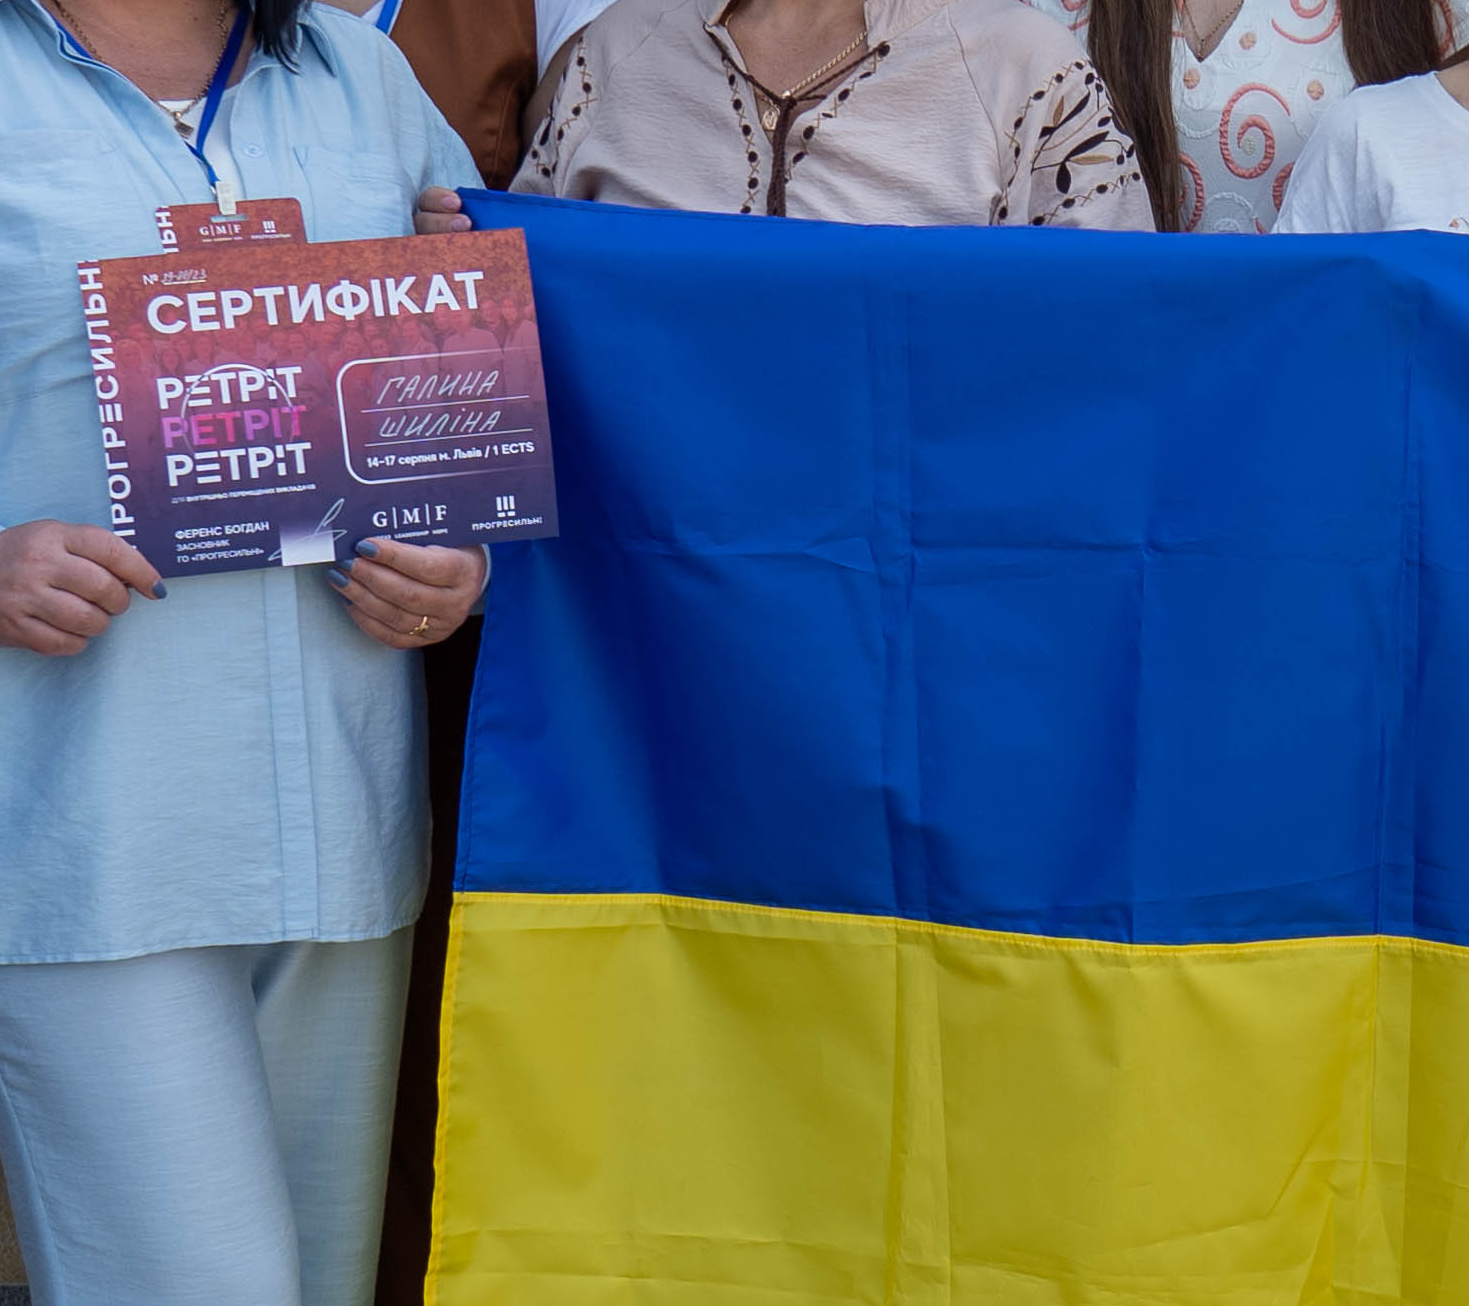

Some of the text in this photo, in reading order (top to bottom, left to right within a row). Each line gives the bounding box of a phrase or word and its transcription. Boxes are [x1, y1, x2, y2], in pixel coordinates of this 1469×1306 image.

[146, 271, 484, 333] СЕРТИФІКАТ
[377, 370, 499, 405] ГАЛИНА
[453, 448, 482, 460] Львів
[501, 442, 535, 454] ECTS
[175, 521, 270, 540] ФЕРЕНС БОГДАН
